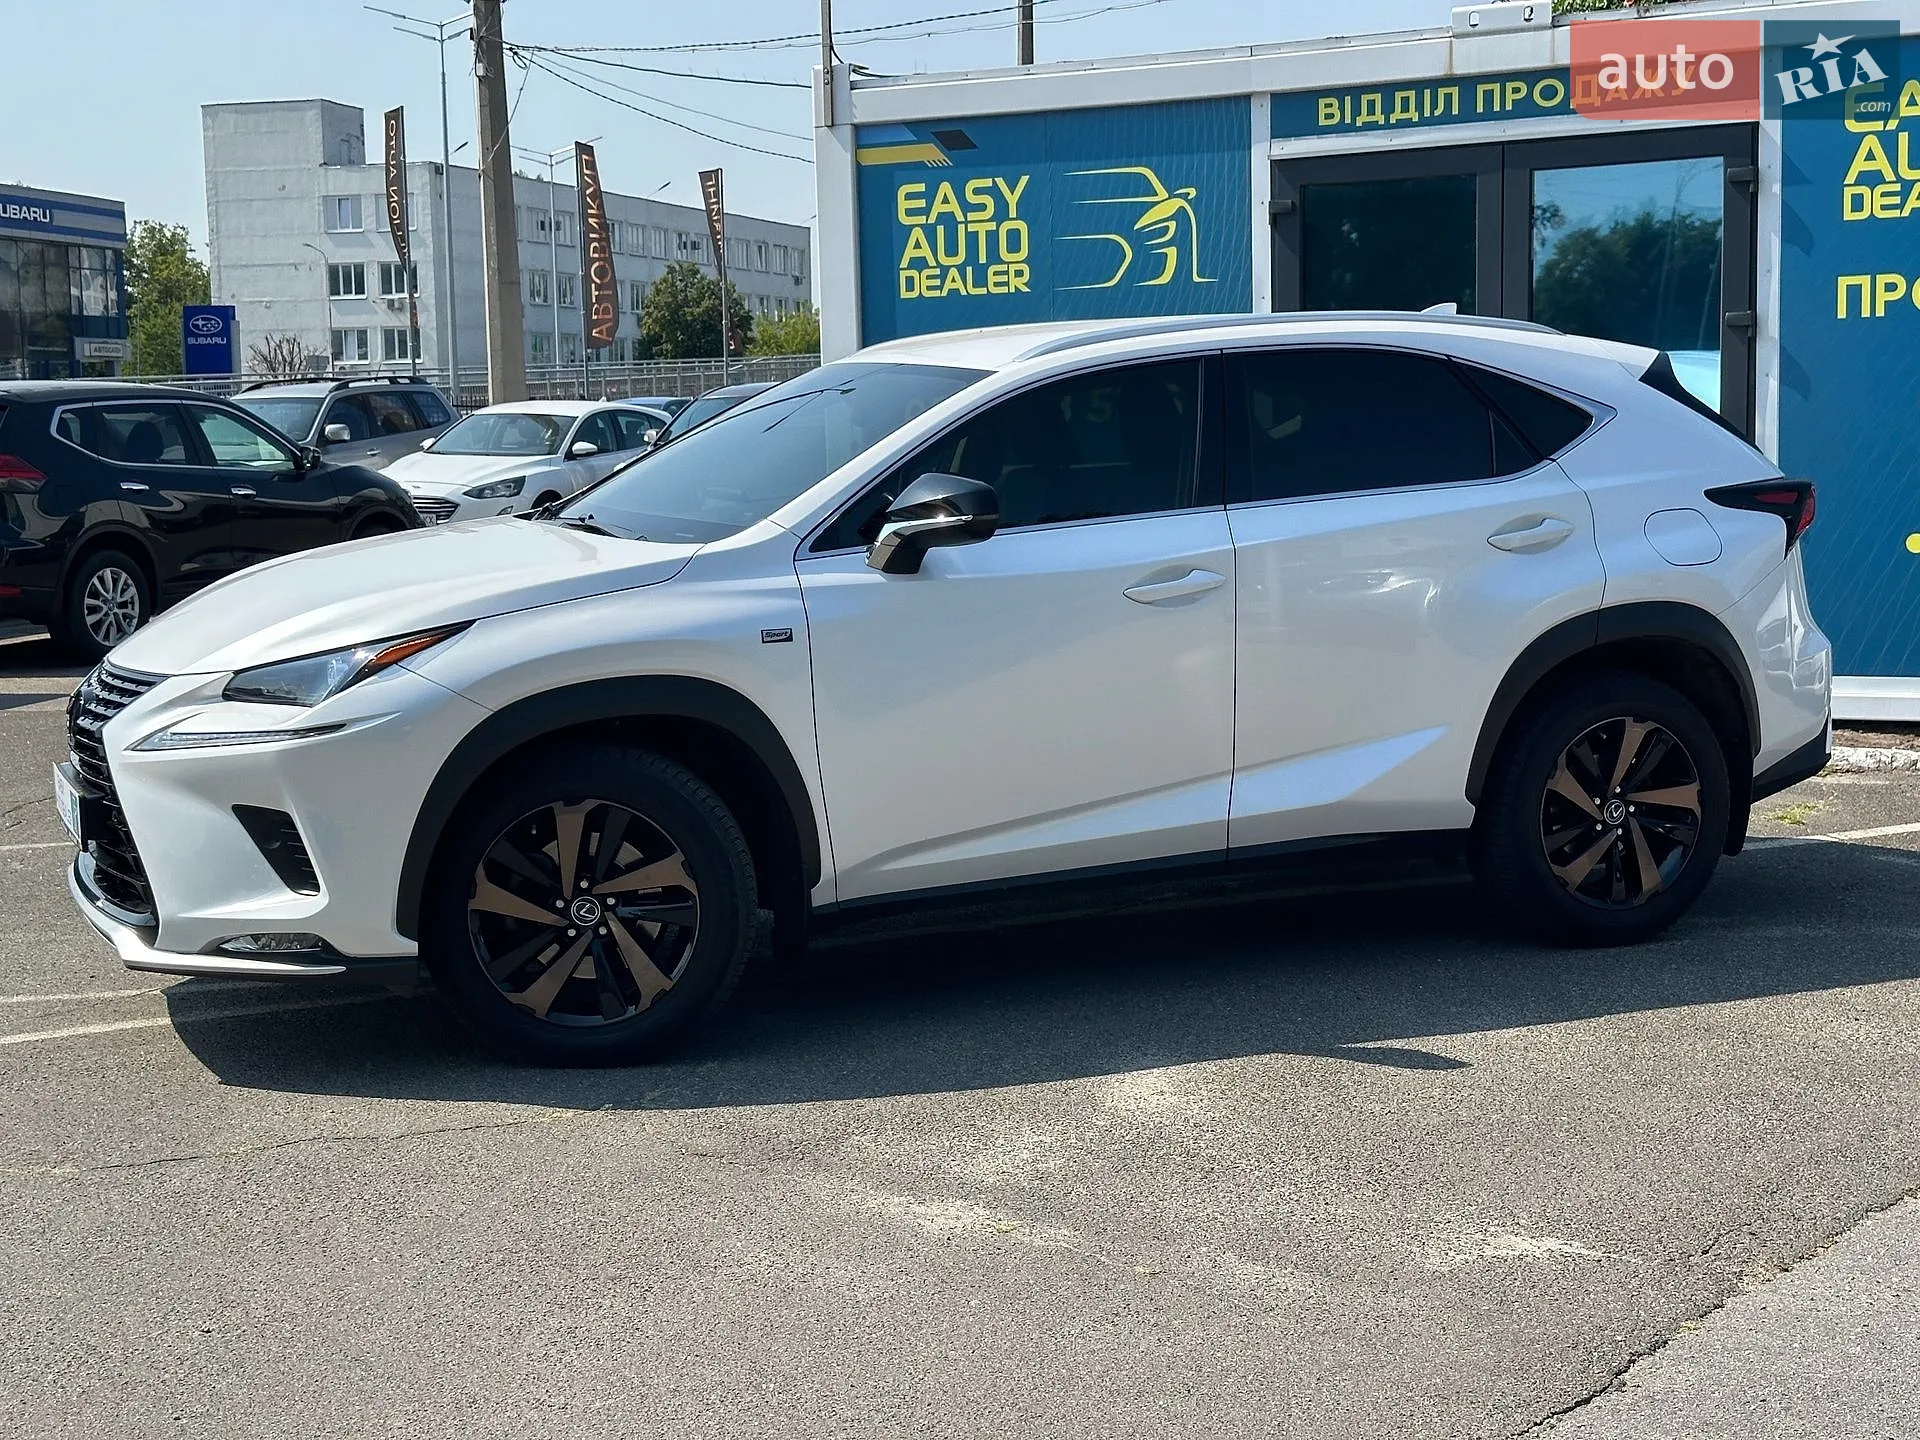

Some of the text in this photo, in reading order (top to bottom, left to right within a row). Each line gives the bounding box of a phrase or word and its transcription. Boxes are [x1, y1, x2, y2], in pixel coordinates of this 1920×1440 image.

[1317, 86, 1460, 127] ВІДДІЛ
[0, 203, 50, 223] UBARU
[897, 175, 1030, 225] EASY
[899, 220, 1029, 269] AUTO
[899, 263, 1032, 299] DEALER
[1837, 273, 1920, 319] ПР
[187, 337, 227, 345] SUBARU
[764, 631, 789, 639] Sport
